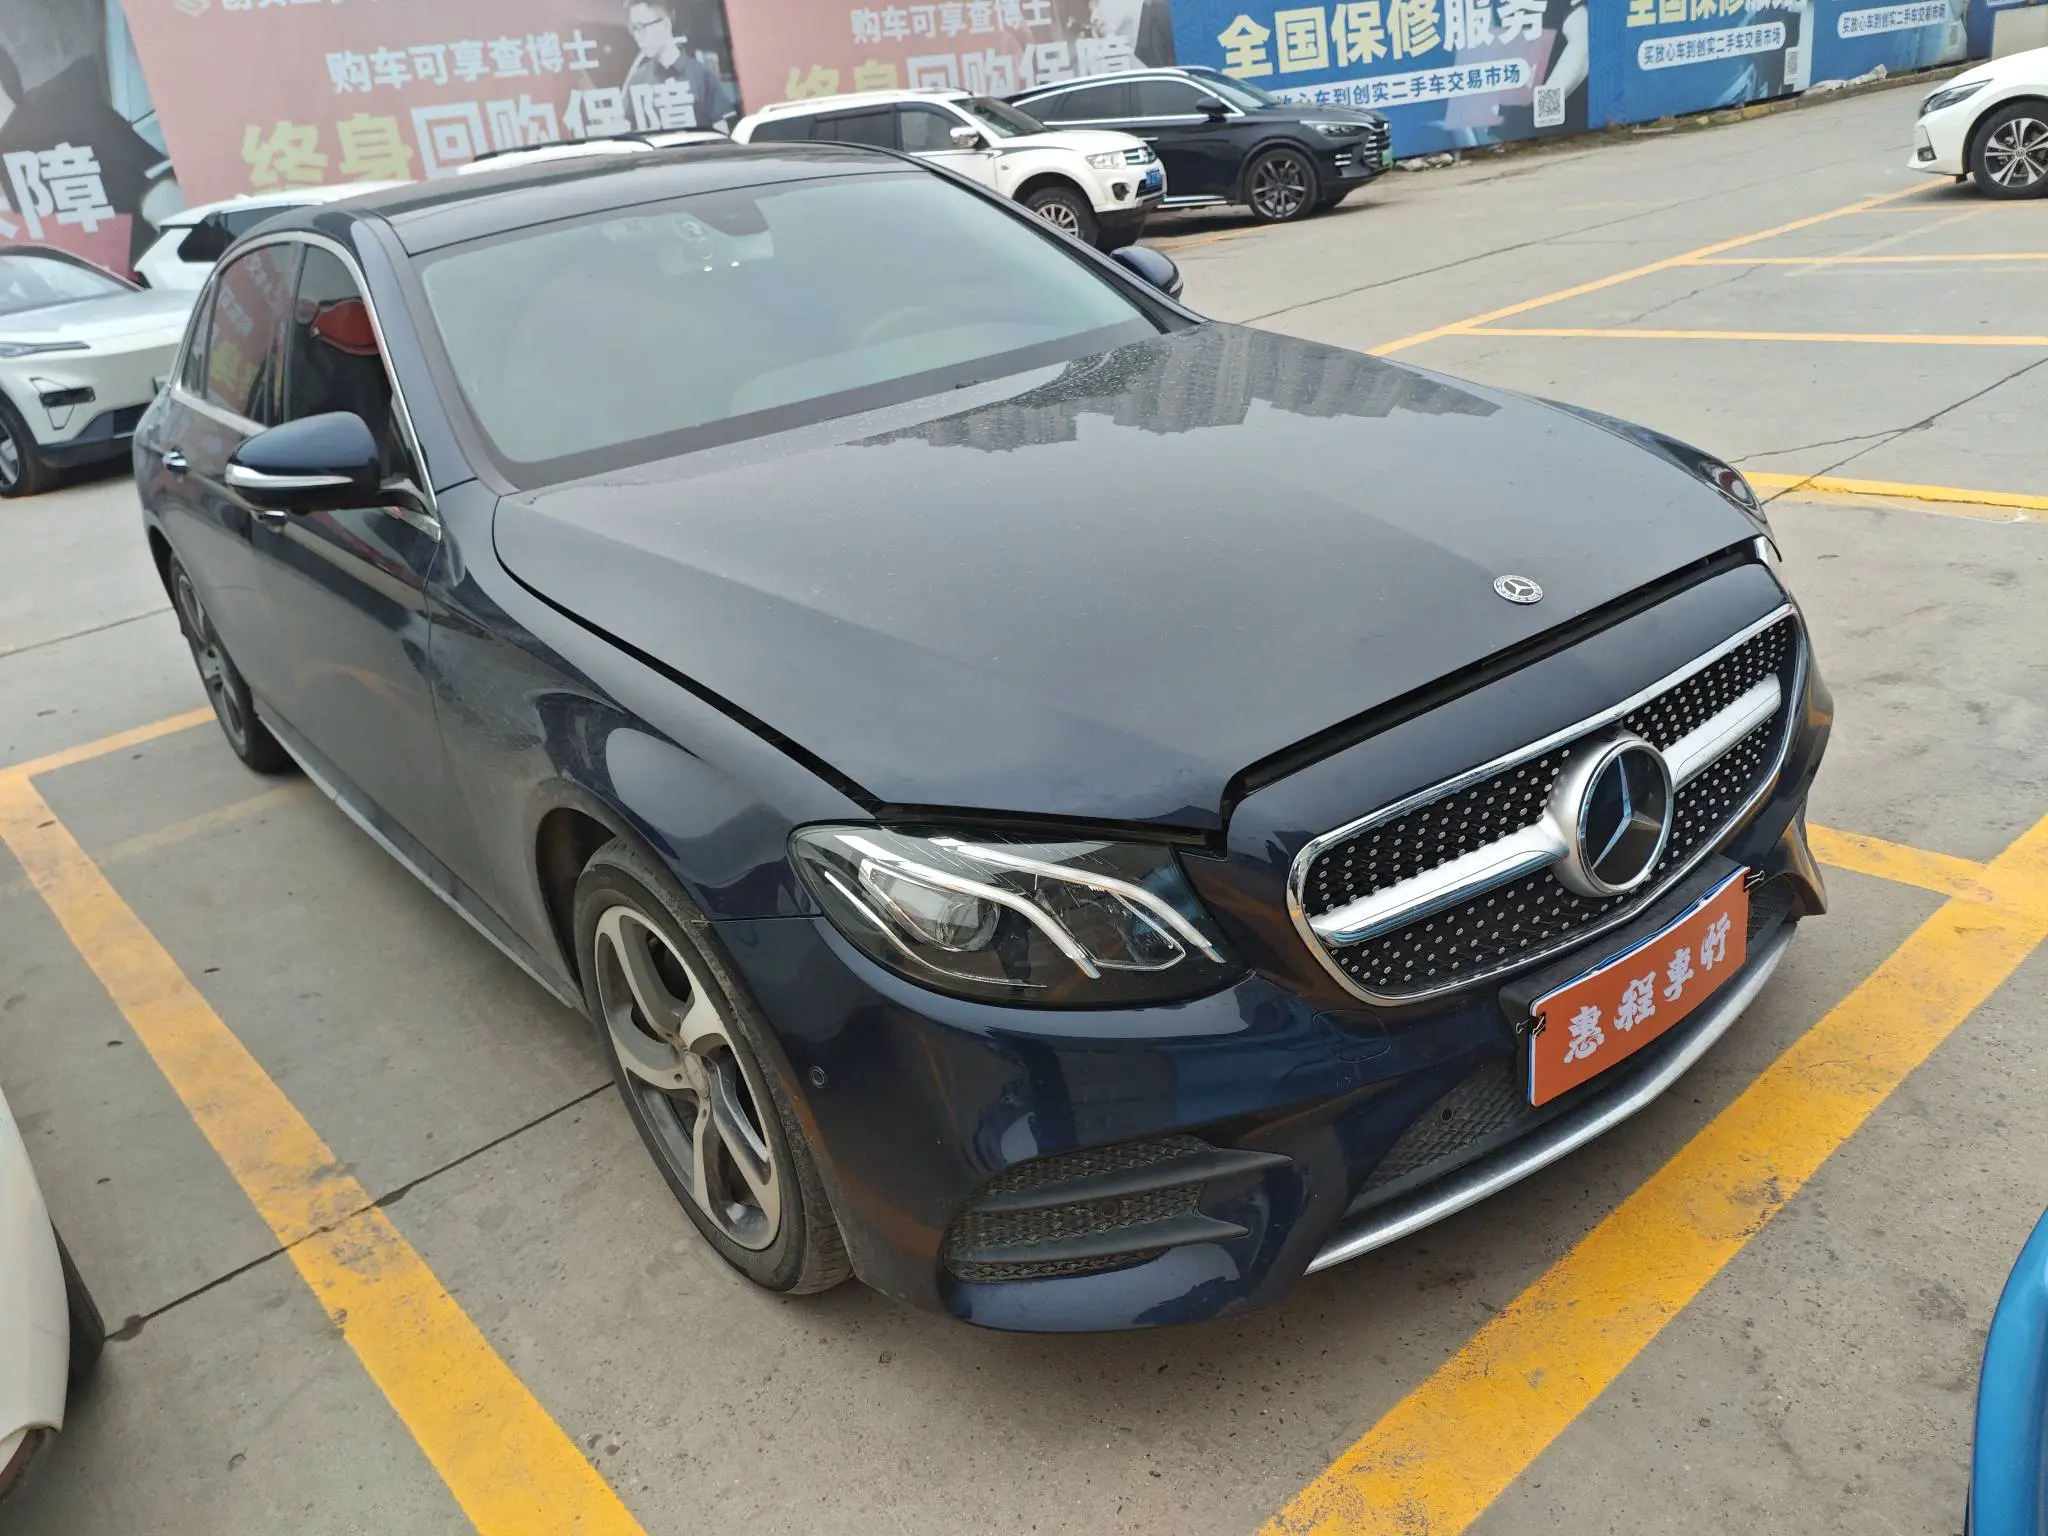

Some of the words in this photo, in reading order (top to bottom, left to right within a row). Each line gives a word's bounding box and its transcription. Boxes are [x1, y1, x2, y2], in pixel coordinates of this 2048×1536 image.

[849, 0, 1051, 44] 购车可享查博士
[1217, 0, 1546, 80] 全国保修服务
[1644, 27, 1780, 64] 买放心车到创实二手车交易市场
[325, 30, 600, 94] 购车可享查博士
[240, 77, 697, 196] 终身回购保障
